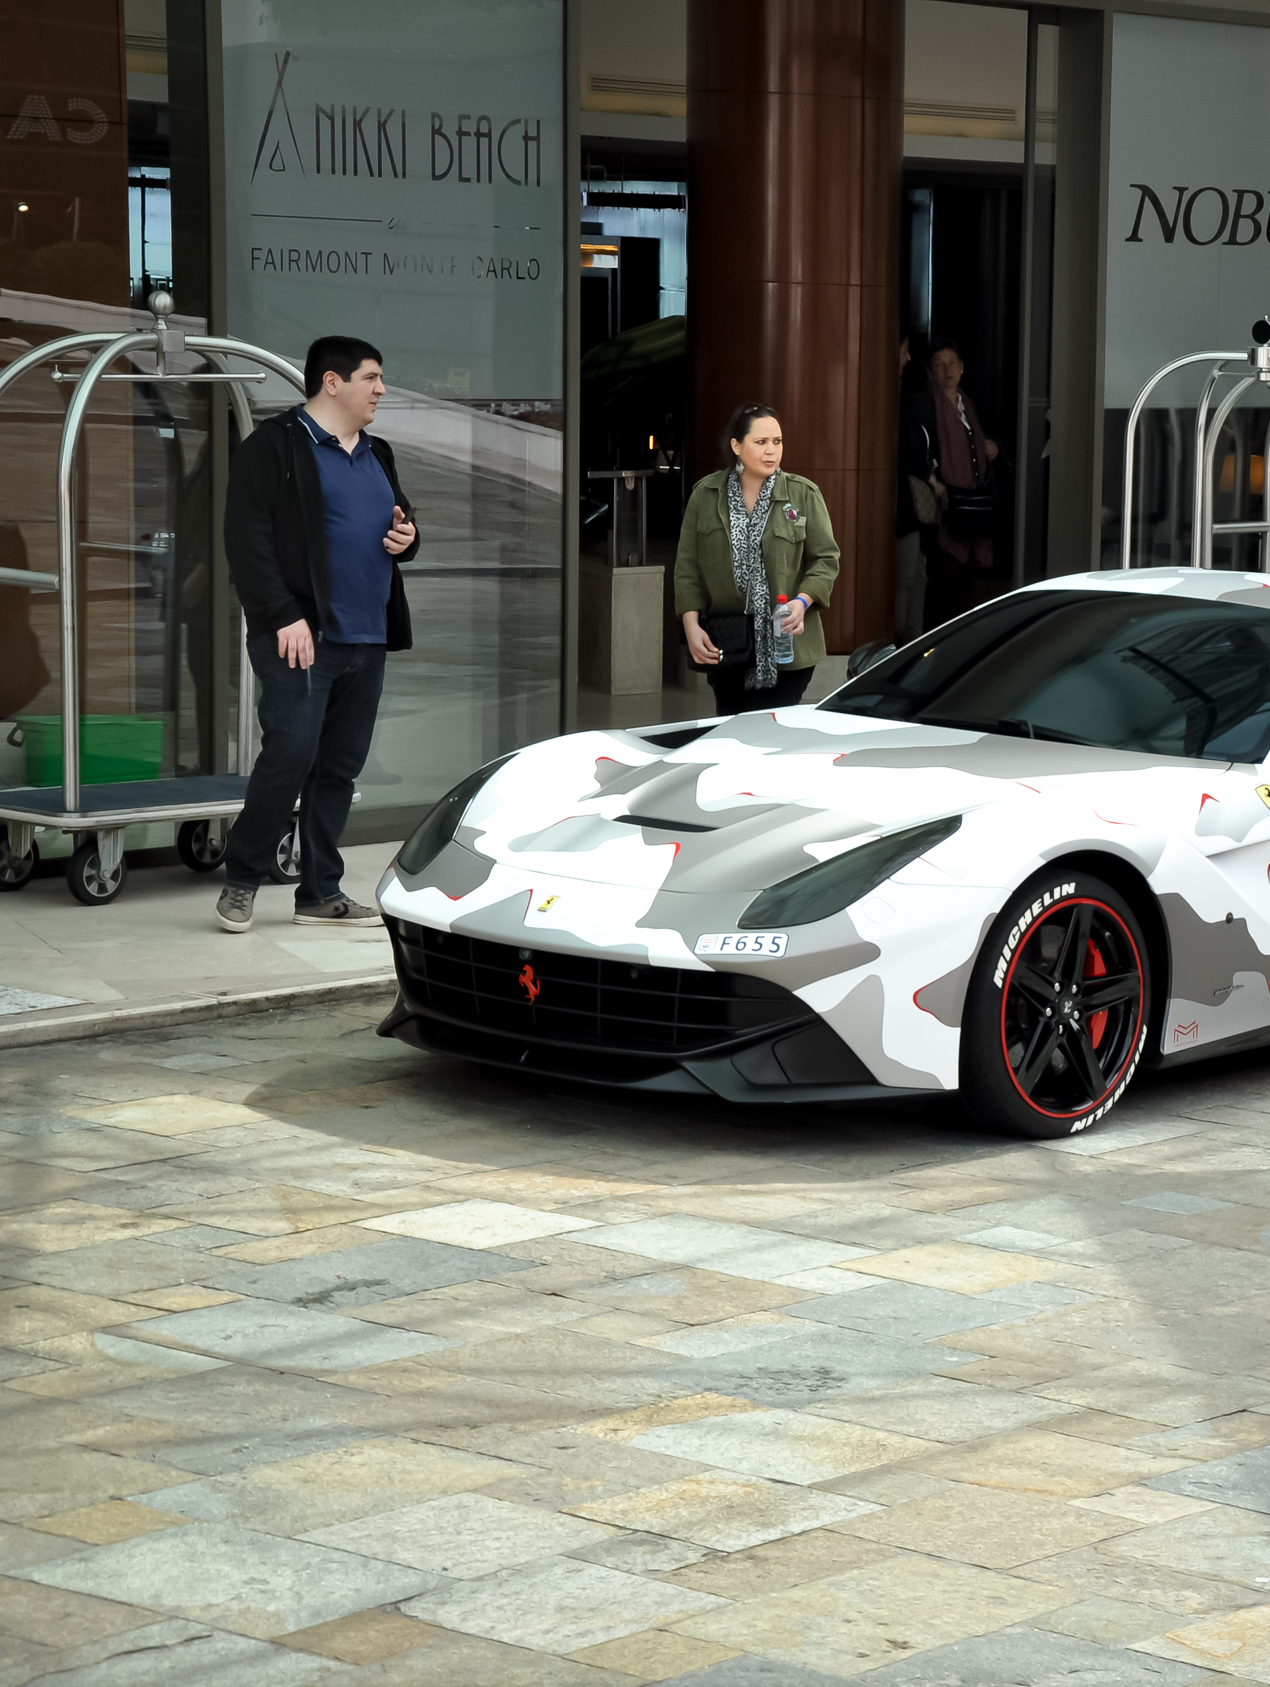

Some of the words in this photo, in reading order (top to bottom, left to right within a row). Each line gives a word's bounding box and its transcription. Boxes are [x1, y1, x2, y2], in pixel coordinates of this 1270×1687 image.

[314, 102, 407, 180] NIKKI
[430, 111, 541, 188] BEACH
[250, 247, 373, 275] FAIRMONT
[471, 255, 541, 281] CARLO
[993, 882, 1076, 989] MICHELIN
[1069, 1024, 1148, 1133] MICHELIN
